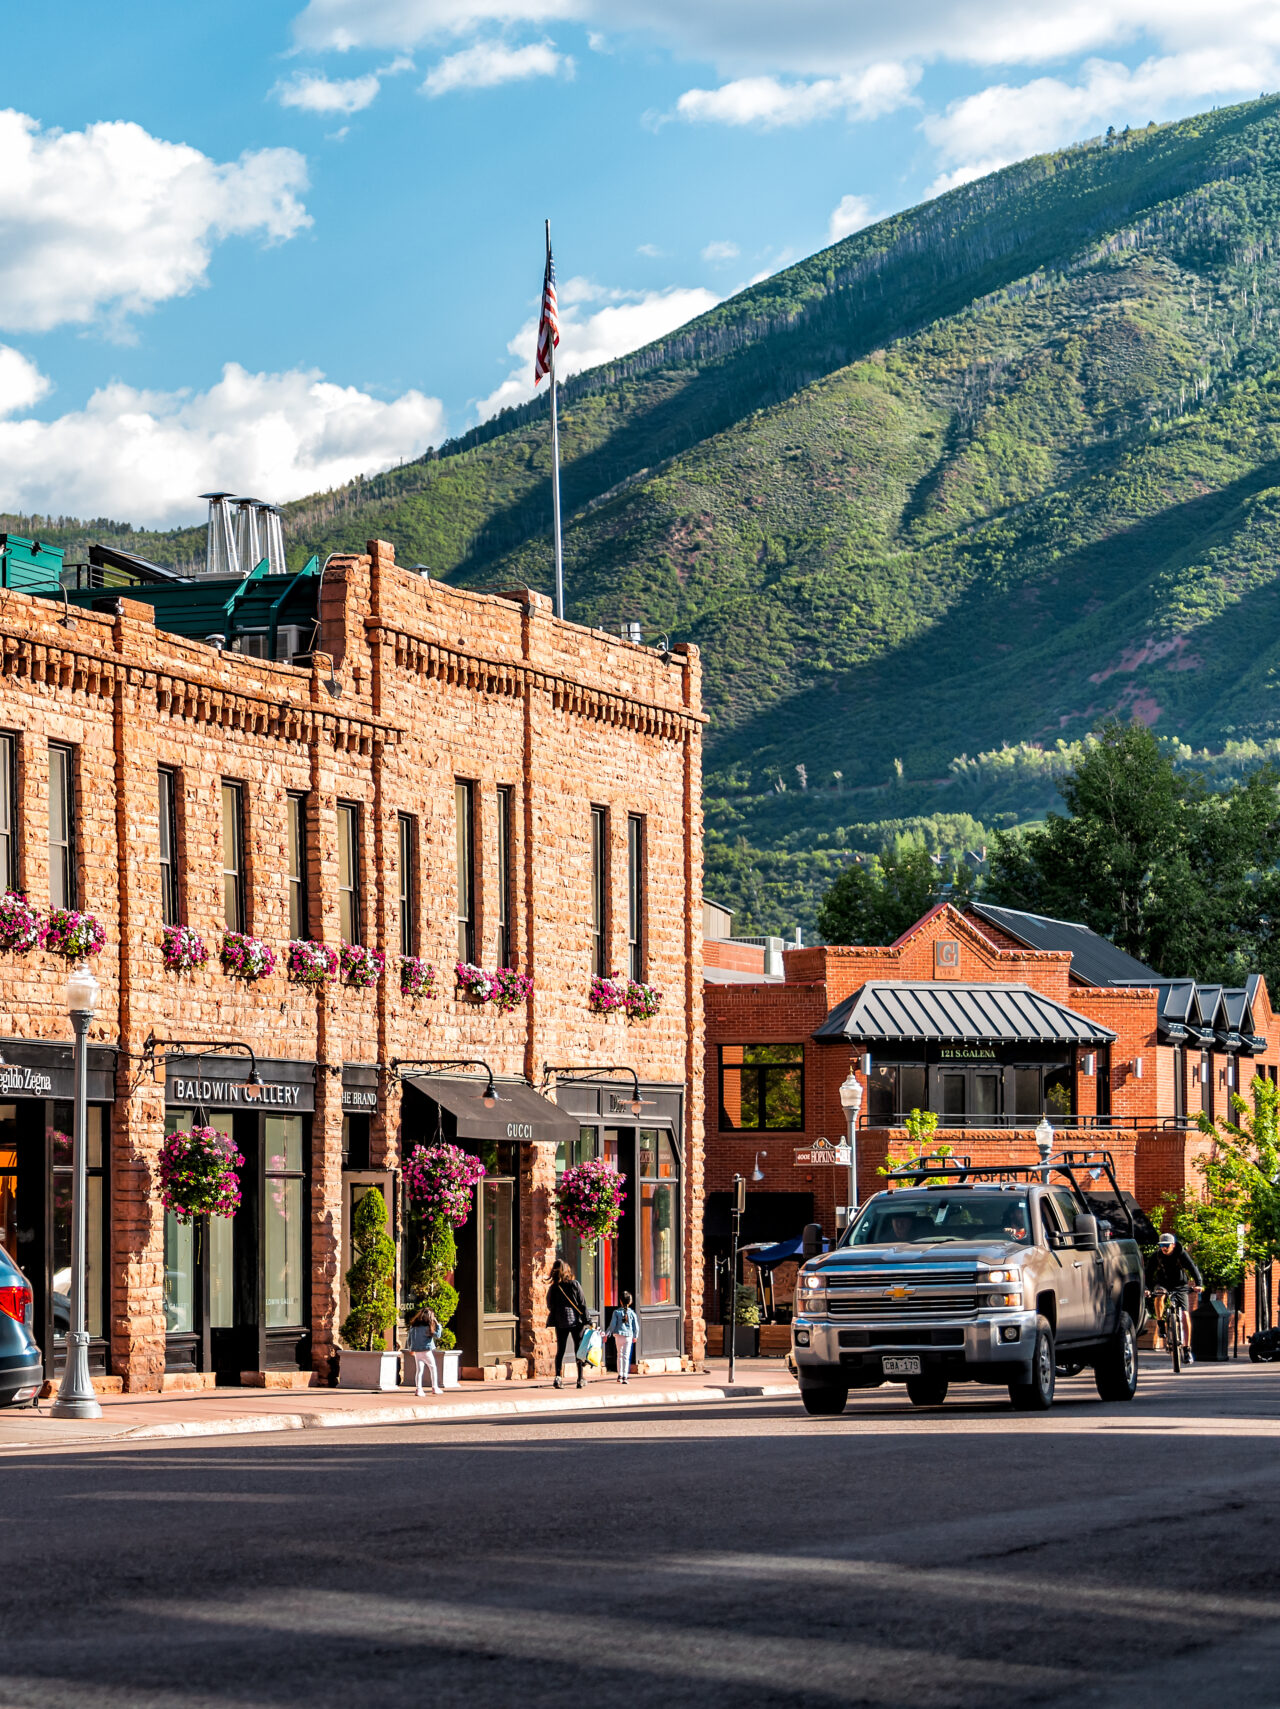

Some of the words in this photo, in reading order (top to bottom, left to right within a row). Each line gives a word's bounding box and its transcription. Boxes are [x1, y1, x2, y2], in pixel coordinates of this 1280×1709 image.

[939, 943, 956, 964] G
[941, 1049, 954, 1058] 121
[24, 1068, 52, 1096] Zegna
[177, 1079, 239, 1101] BALDWIN
[243, 1083, 300, 1105] GALLERY
[353, 1092, 377, 1106] BRAND
[506, 1123, 533, 1139] GUCCI
[811, 1150, 835, 1164] HOPKINS
[973, 1170, 1017, 1182] ASPEN
